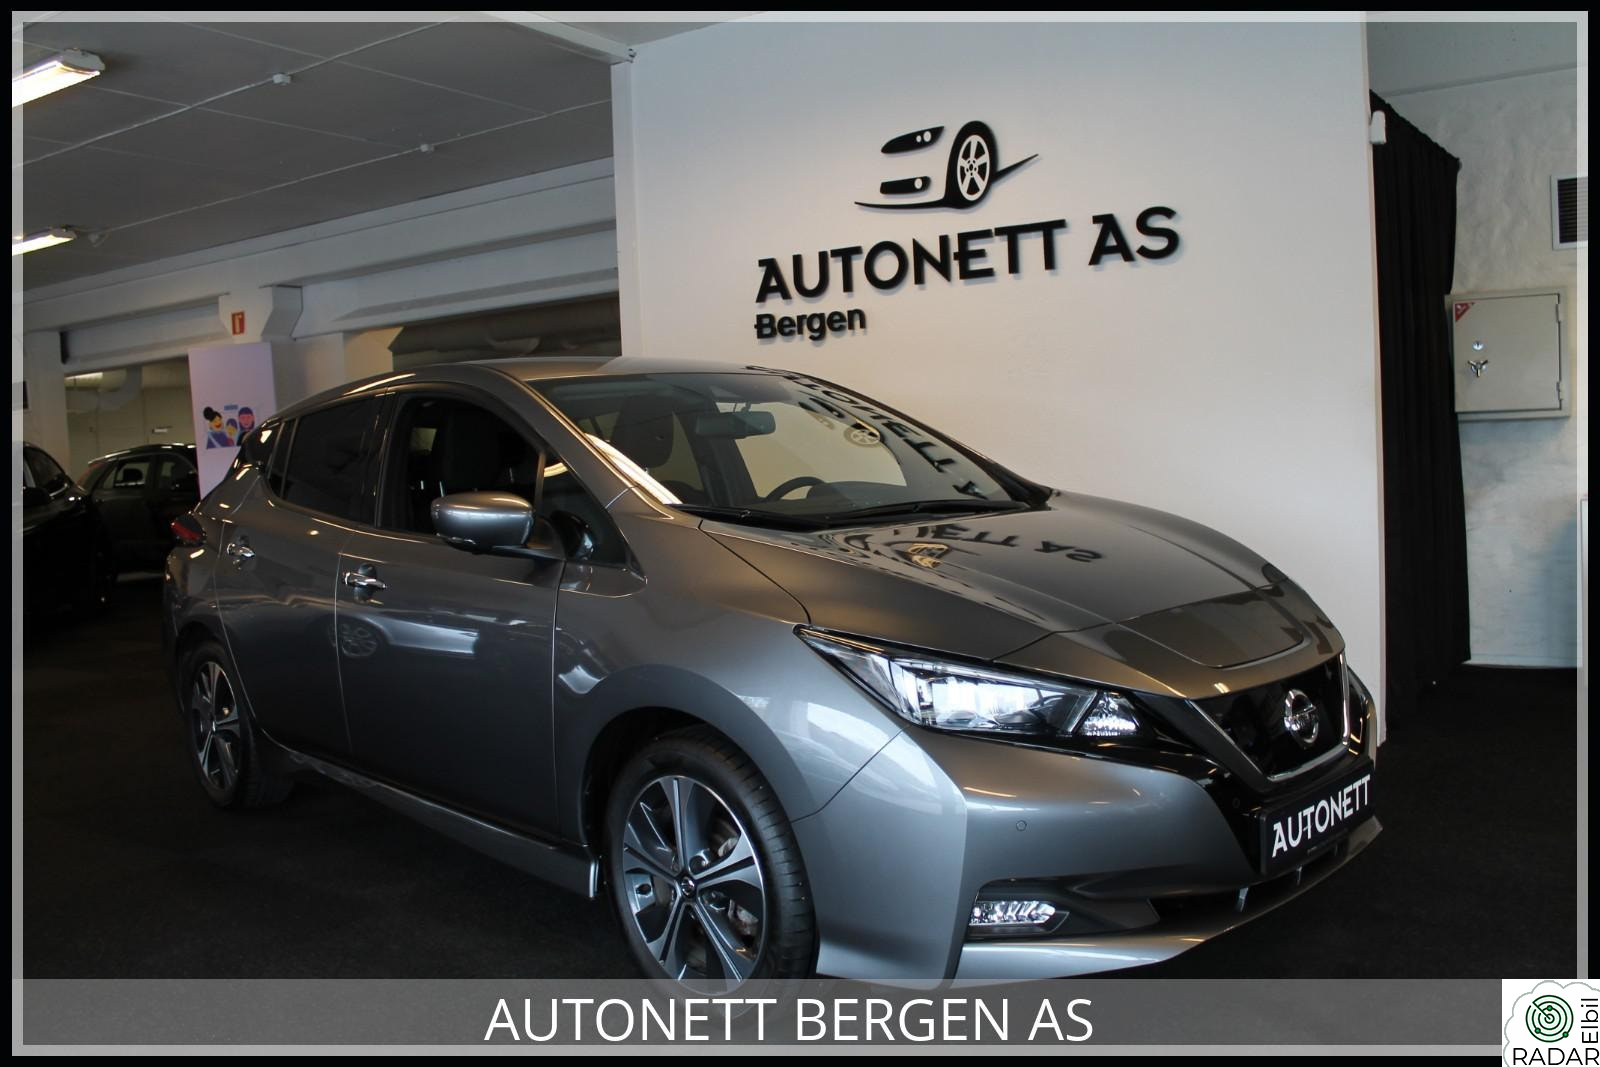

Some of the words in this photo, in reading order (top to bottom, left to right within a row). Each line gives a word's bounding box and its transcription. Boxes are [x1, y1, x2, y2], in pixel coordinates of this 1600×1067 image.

[755, 218, 1067, 303] AUTONETT
[1089, 206, 1181, 266] AS
[754, 308, 867, 341] Bergen
[1272, 774, 1371, 858] AUTONETT
